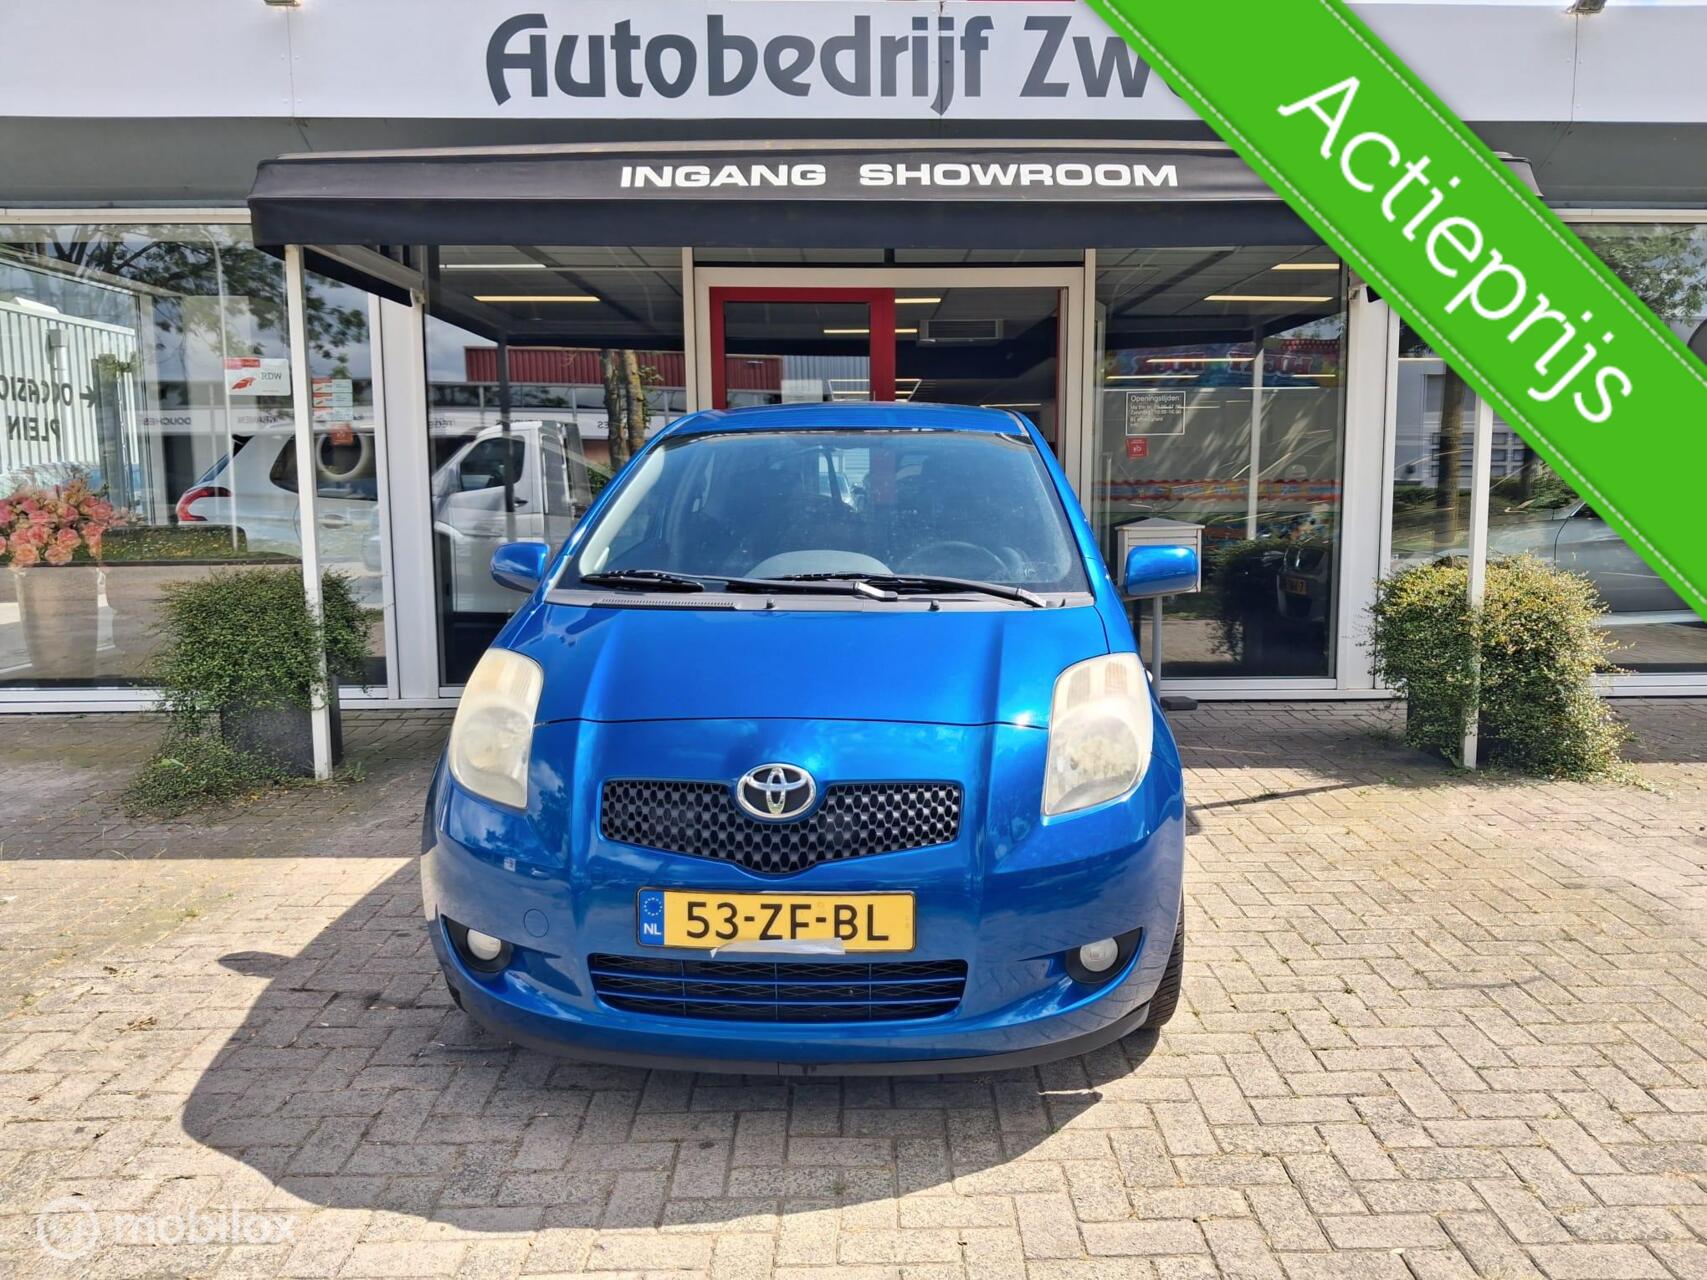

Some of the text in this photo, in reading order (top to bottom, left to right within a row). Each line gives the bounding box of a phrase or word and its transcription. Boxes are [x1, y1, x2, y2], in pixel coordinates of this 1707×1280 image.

[486, 13, 1183, 117] Autobedrijf Zw
[620, 163, 1178, 188] INGANG SHOWROOM
[260, 371, 282, 381] RDW
[643, 922, 662, 936] NL
[686, 901, 889, 941] 53-ZF-BL
